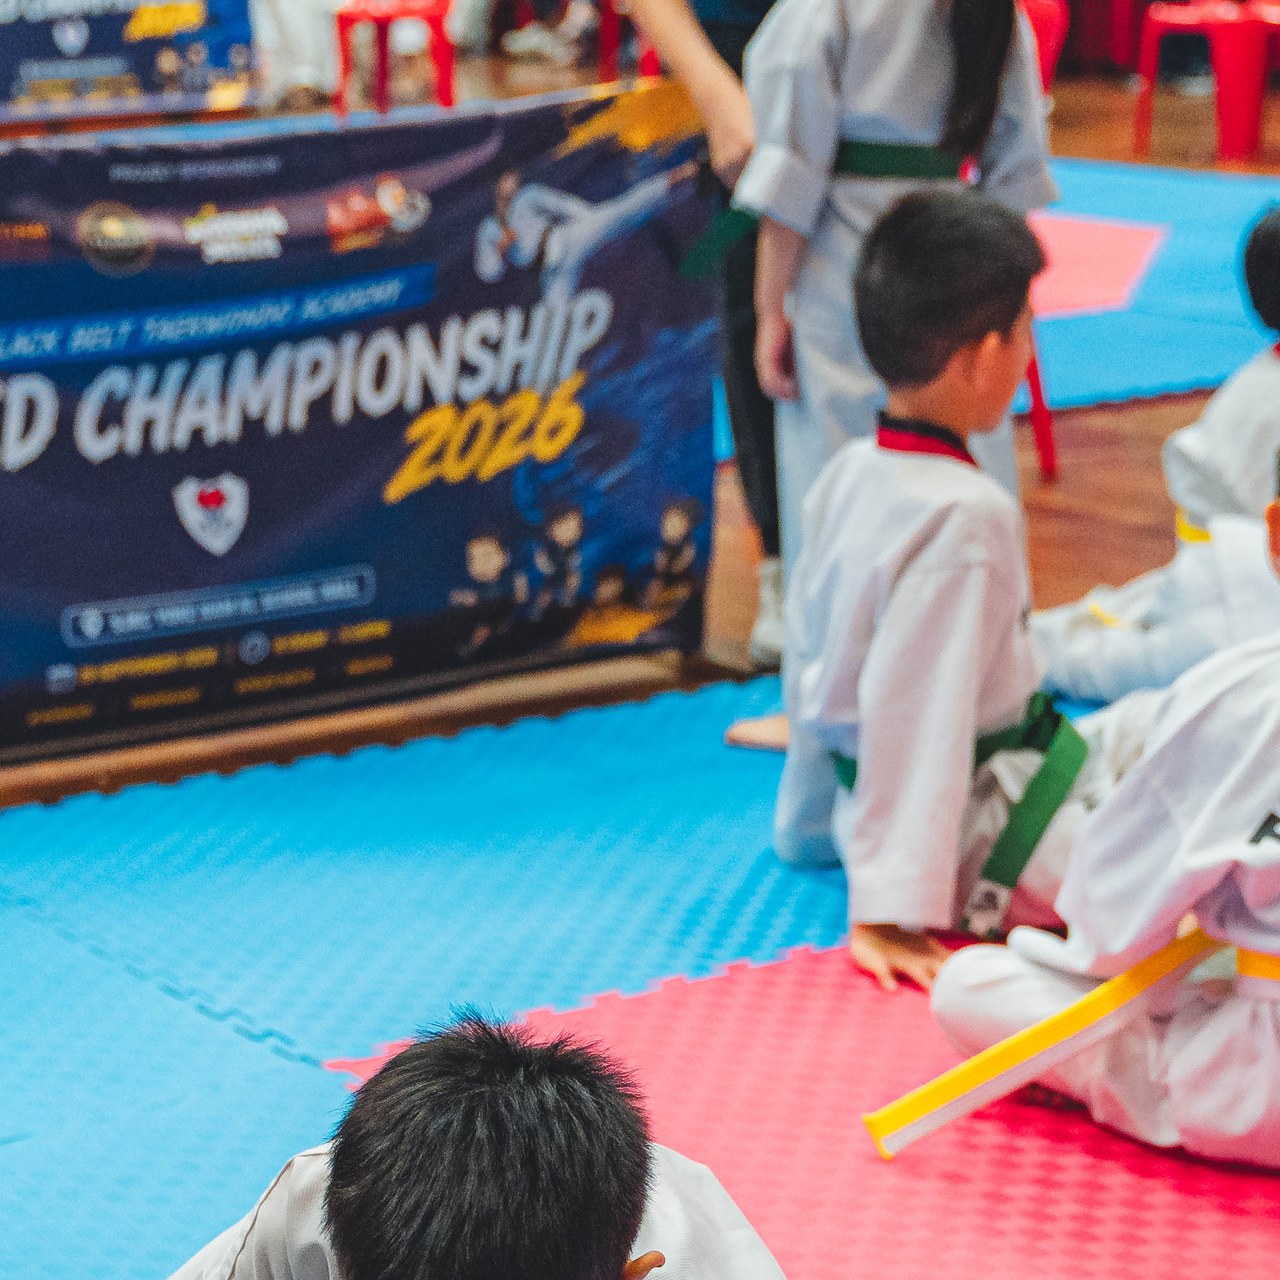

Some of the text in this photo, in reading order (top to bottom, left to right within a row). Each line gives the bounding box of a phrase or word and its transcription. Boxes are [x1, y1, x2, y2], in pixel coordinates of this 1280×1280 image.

[68, 320, 133, 354] BELT
[74, 288, 613, 463] CHAMPIONSHIP
[382, 371, 587, 503] 2026
